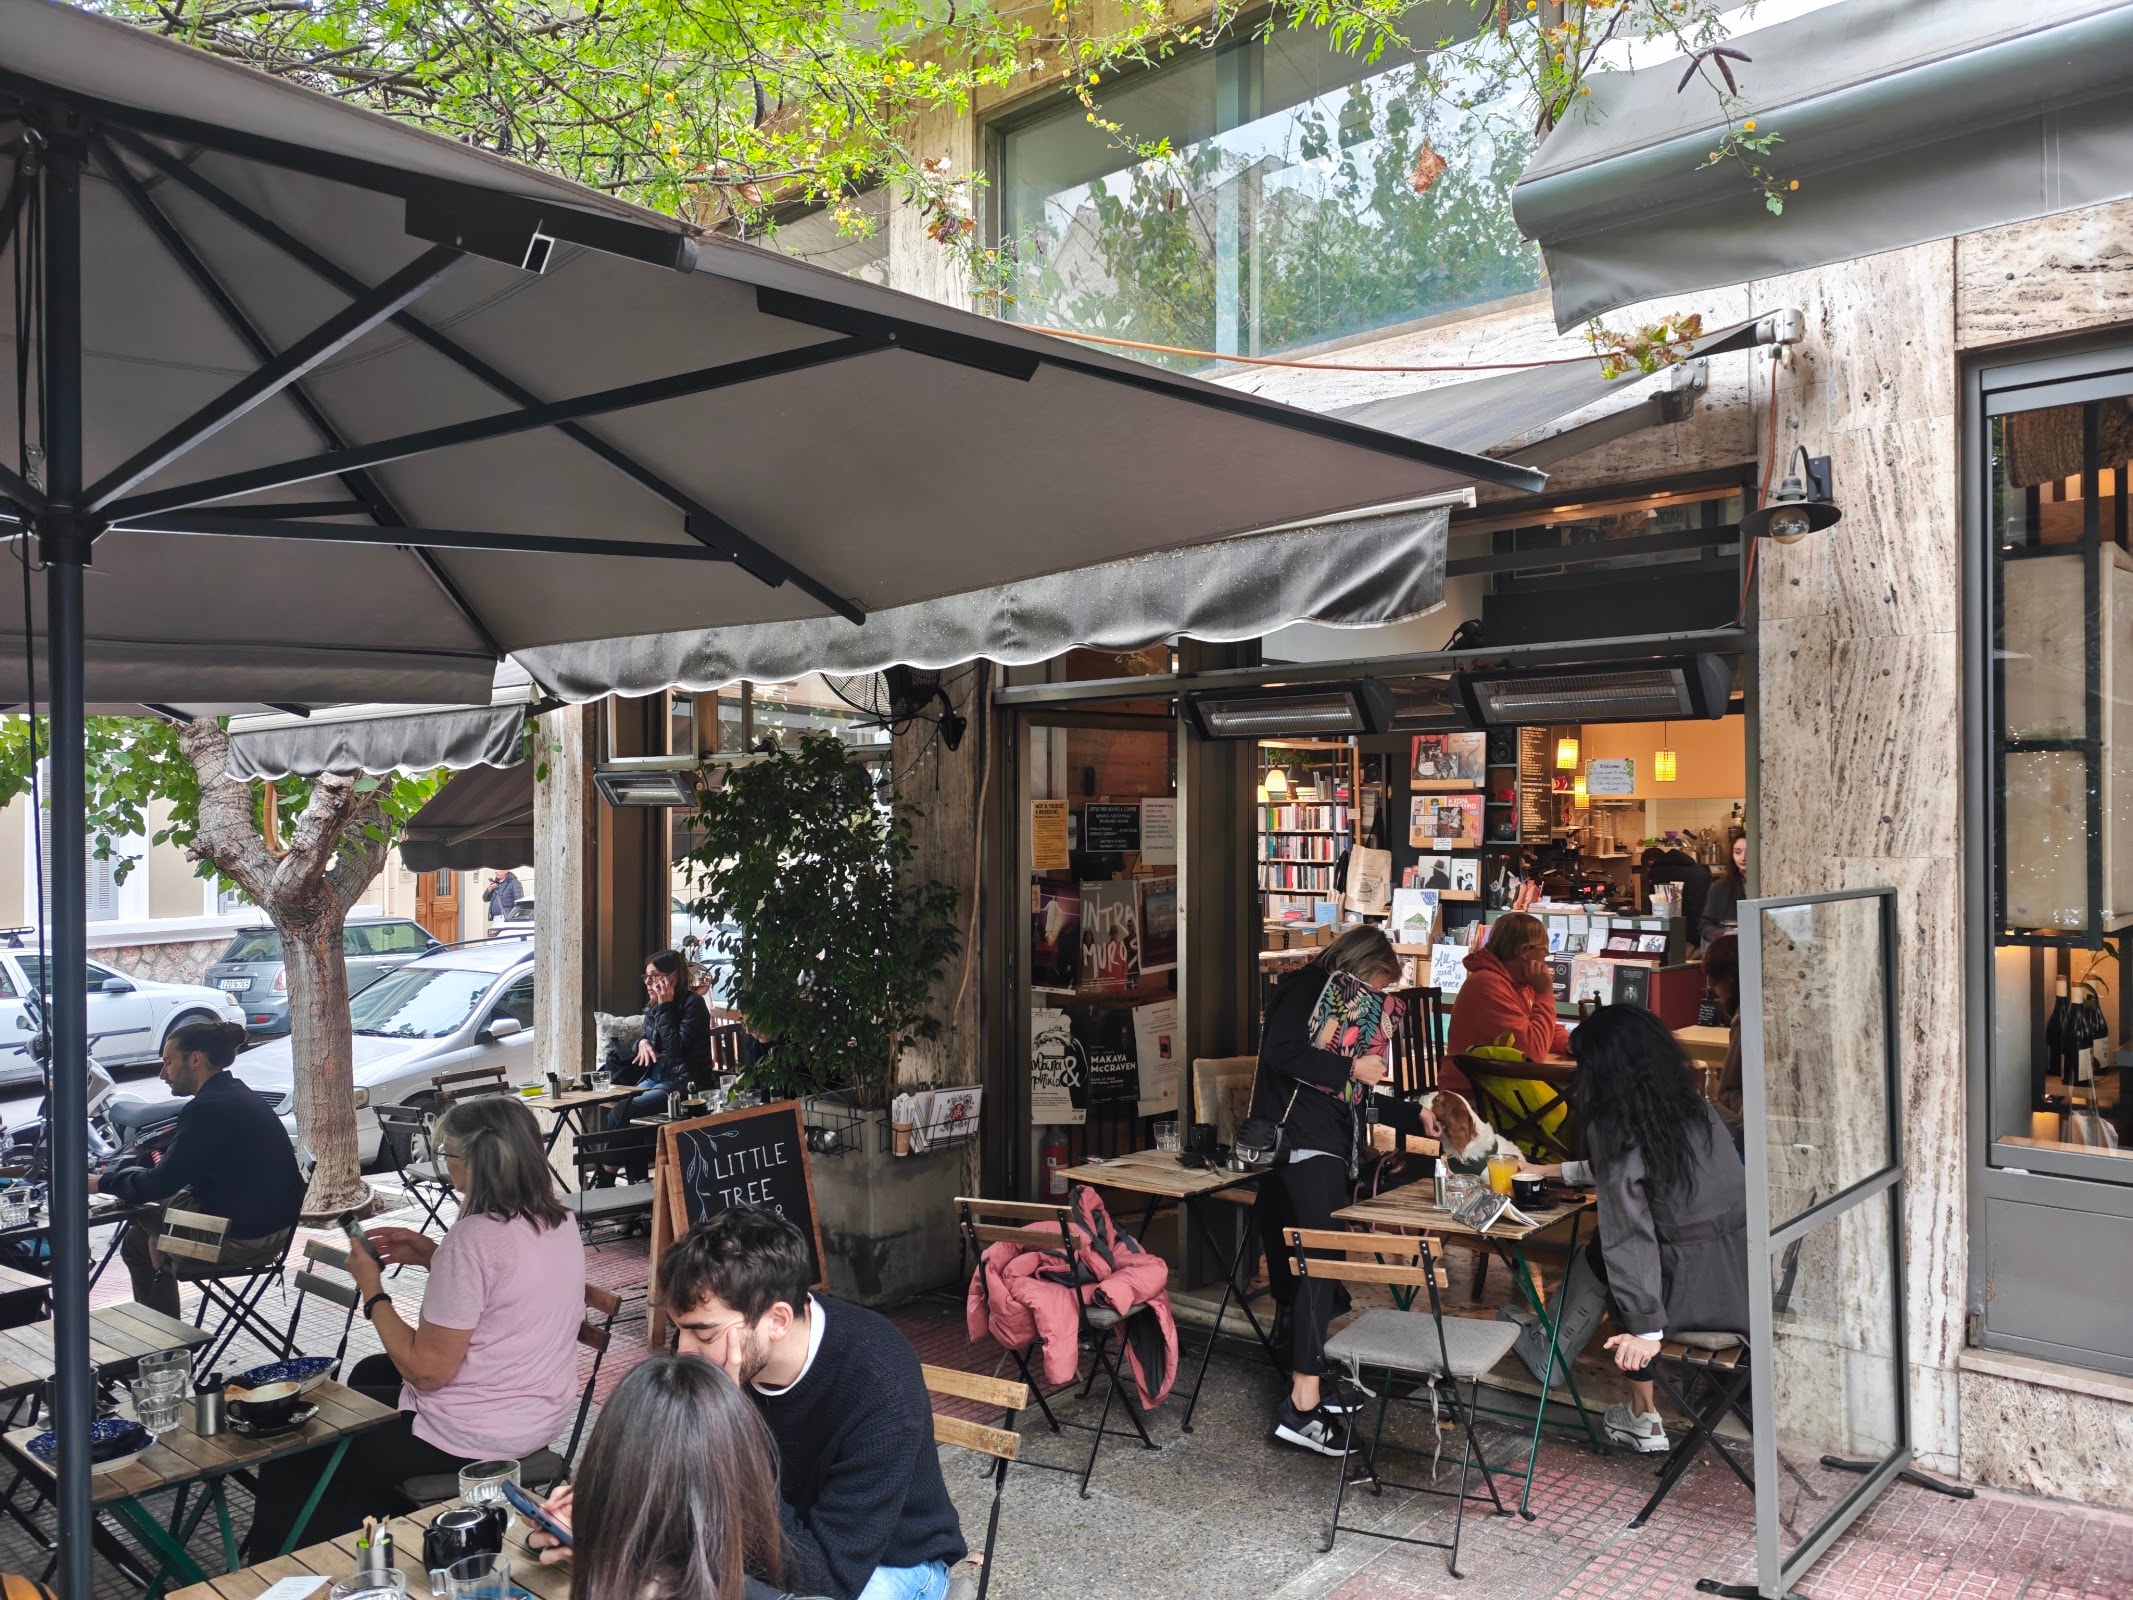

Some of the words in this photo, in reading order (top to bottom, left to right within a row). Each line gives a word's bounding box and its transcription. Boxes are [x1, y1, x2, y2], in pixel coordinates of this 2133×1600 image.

[1083, 893, 1137, 935] INTRA
[1082, 938, 1138, 978] MUROS
[1090, 1053, 1127, 1064] MAKAYA
[1090, 1061, 1136, 1073] McCRAVEN
[714, 1142, 788, 1180] LITTLE
[719, 1177, 775, 1209] TREE
